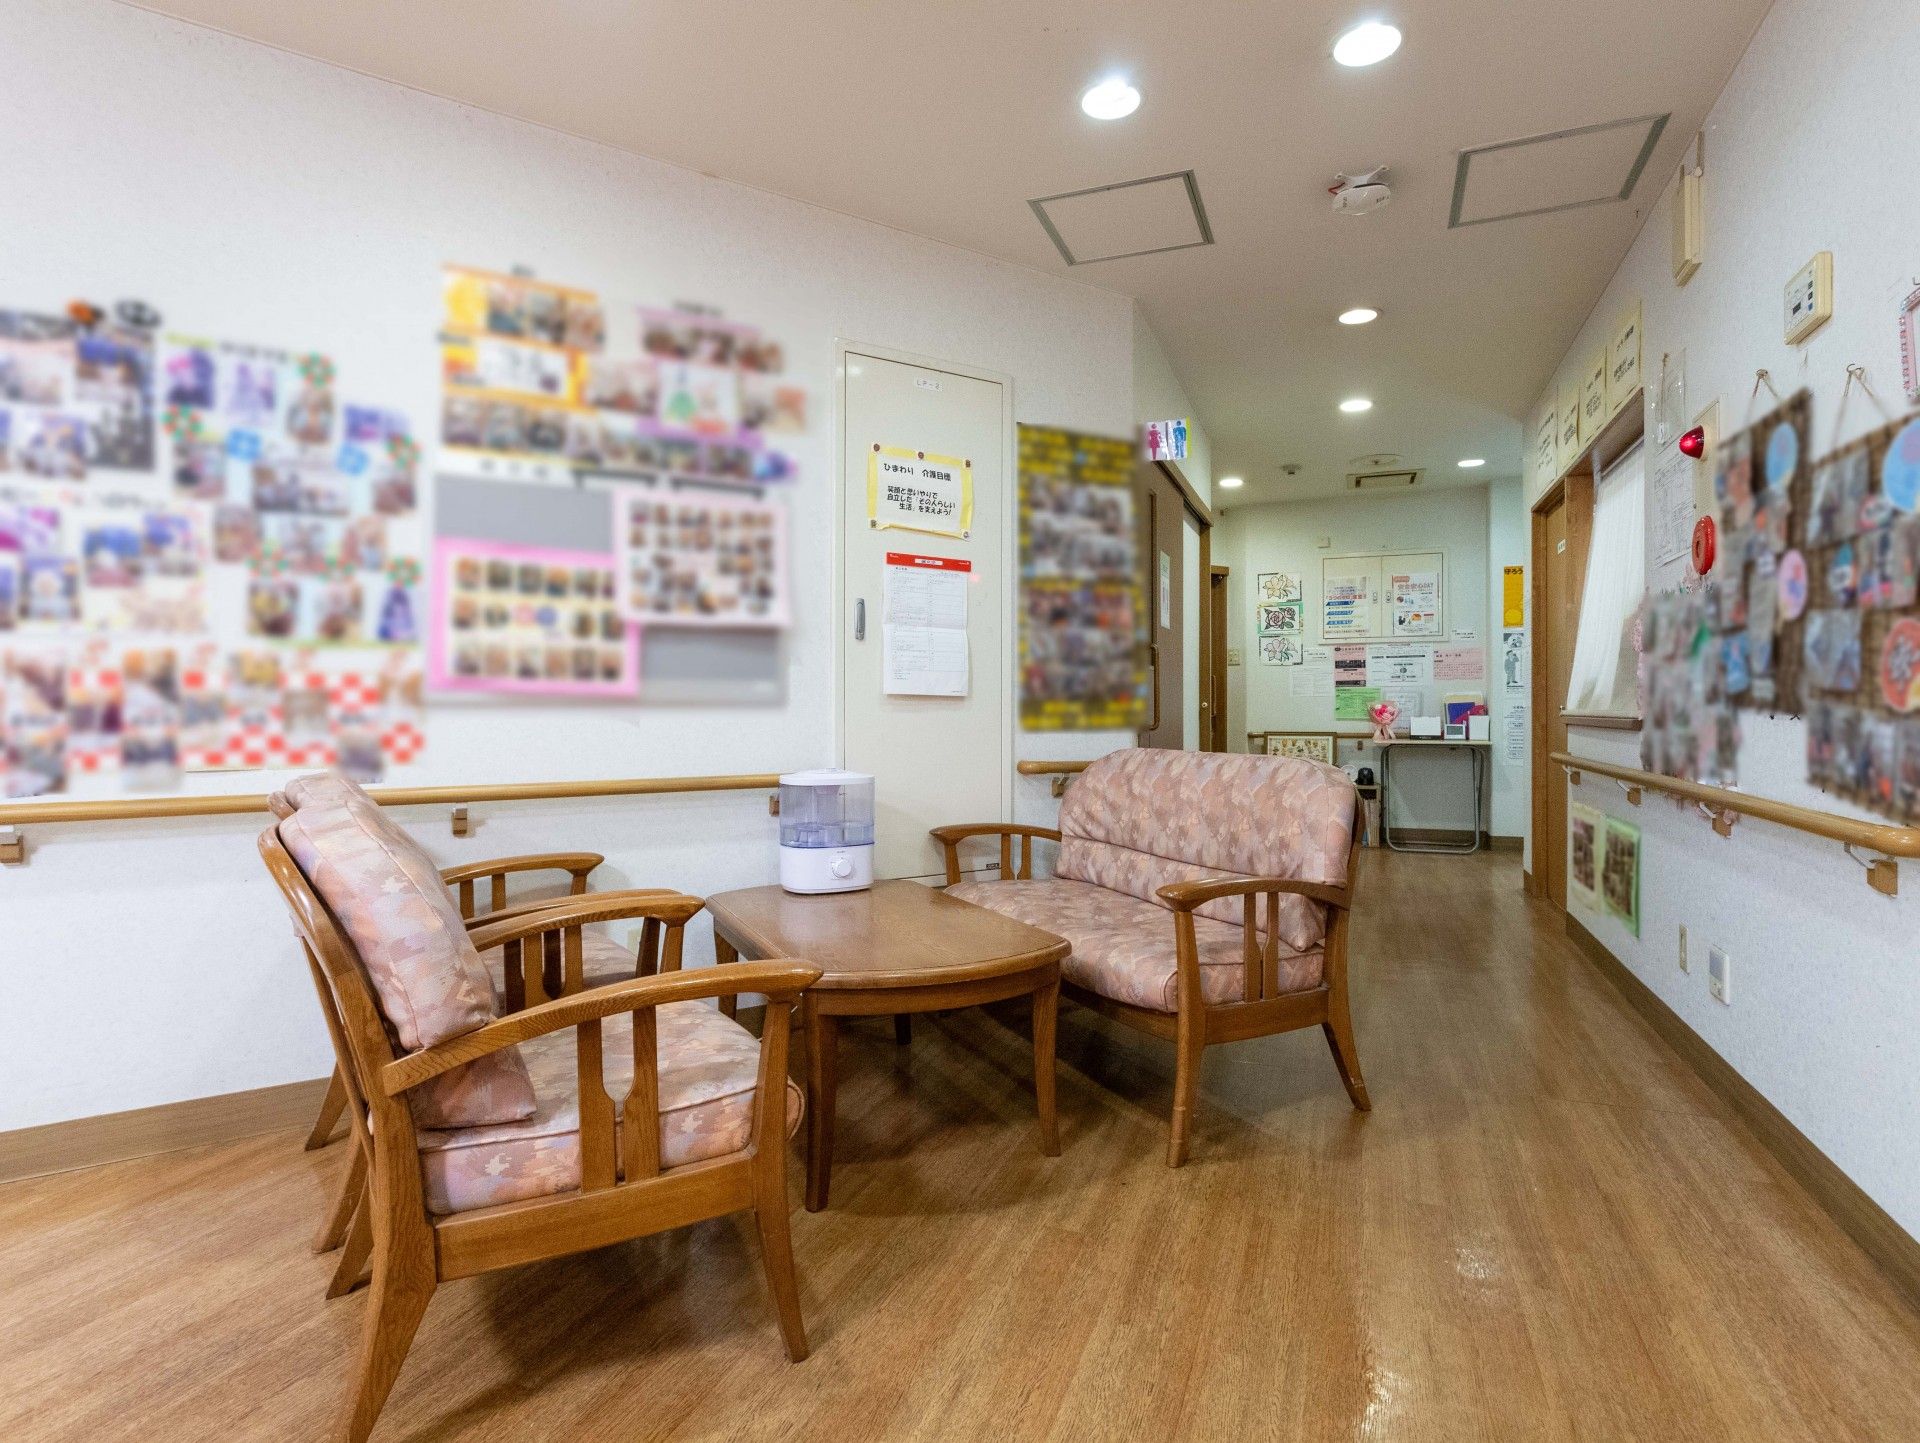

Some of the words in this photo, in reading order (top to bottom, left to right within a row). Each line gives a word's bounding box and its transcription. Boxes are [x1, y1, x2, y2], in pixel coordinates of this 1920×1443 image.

[884, 463, 914, 475] ひまわり
[922, 469, 952, 482] 介護目標
[888, 485, 938, 499] 笑顔と思いやりで
